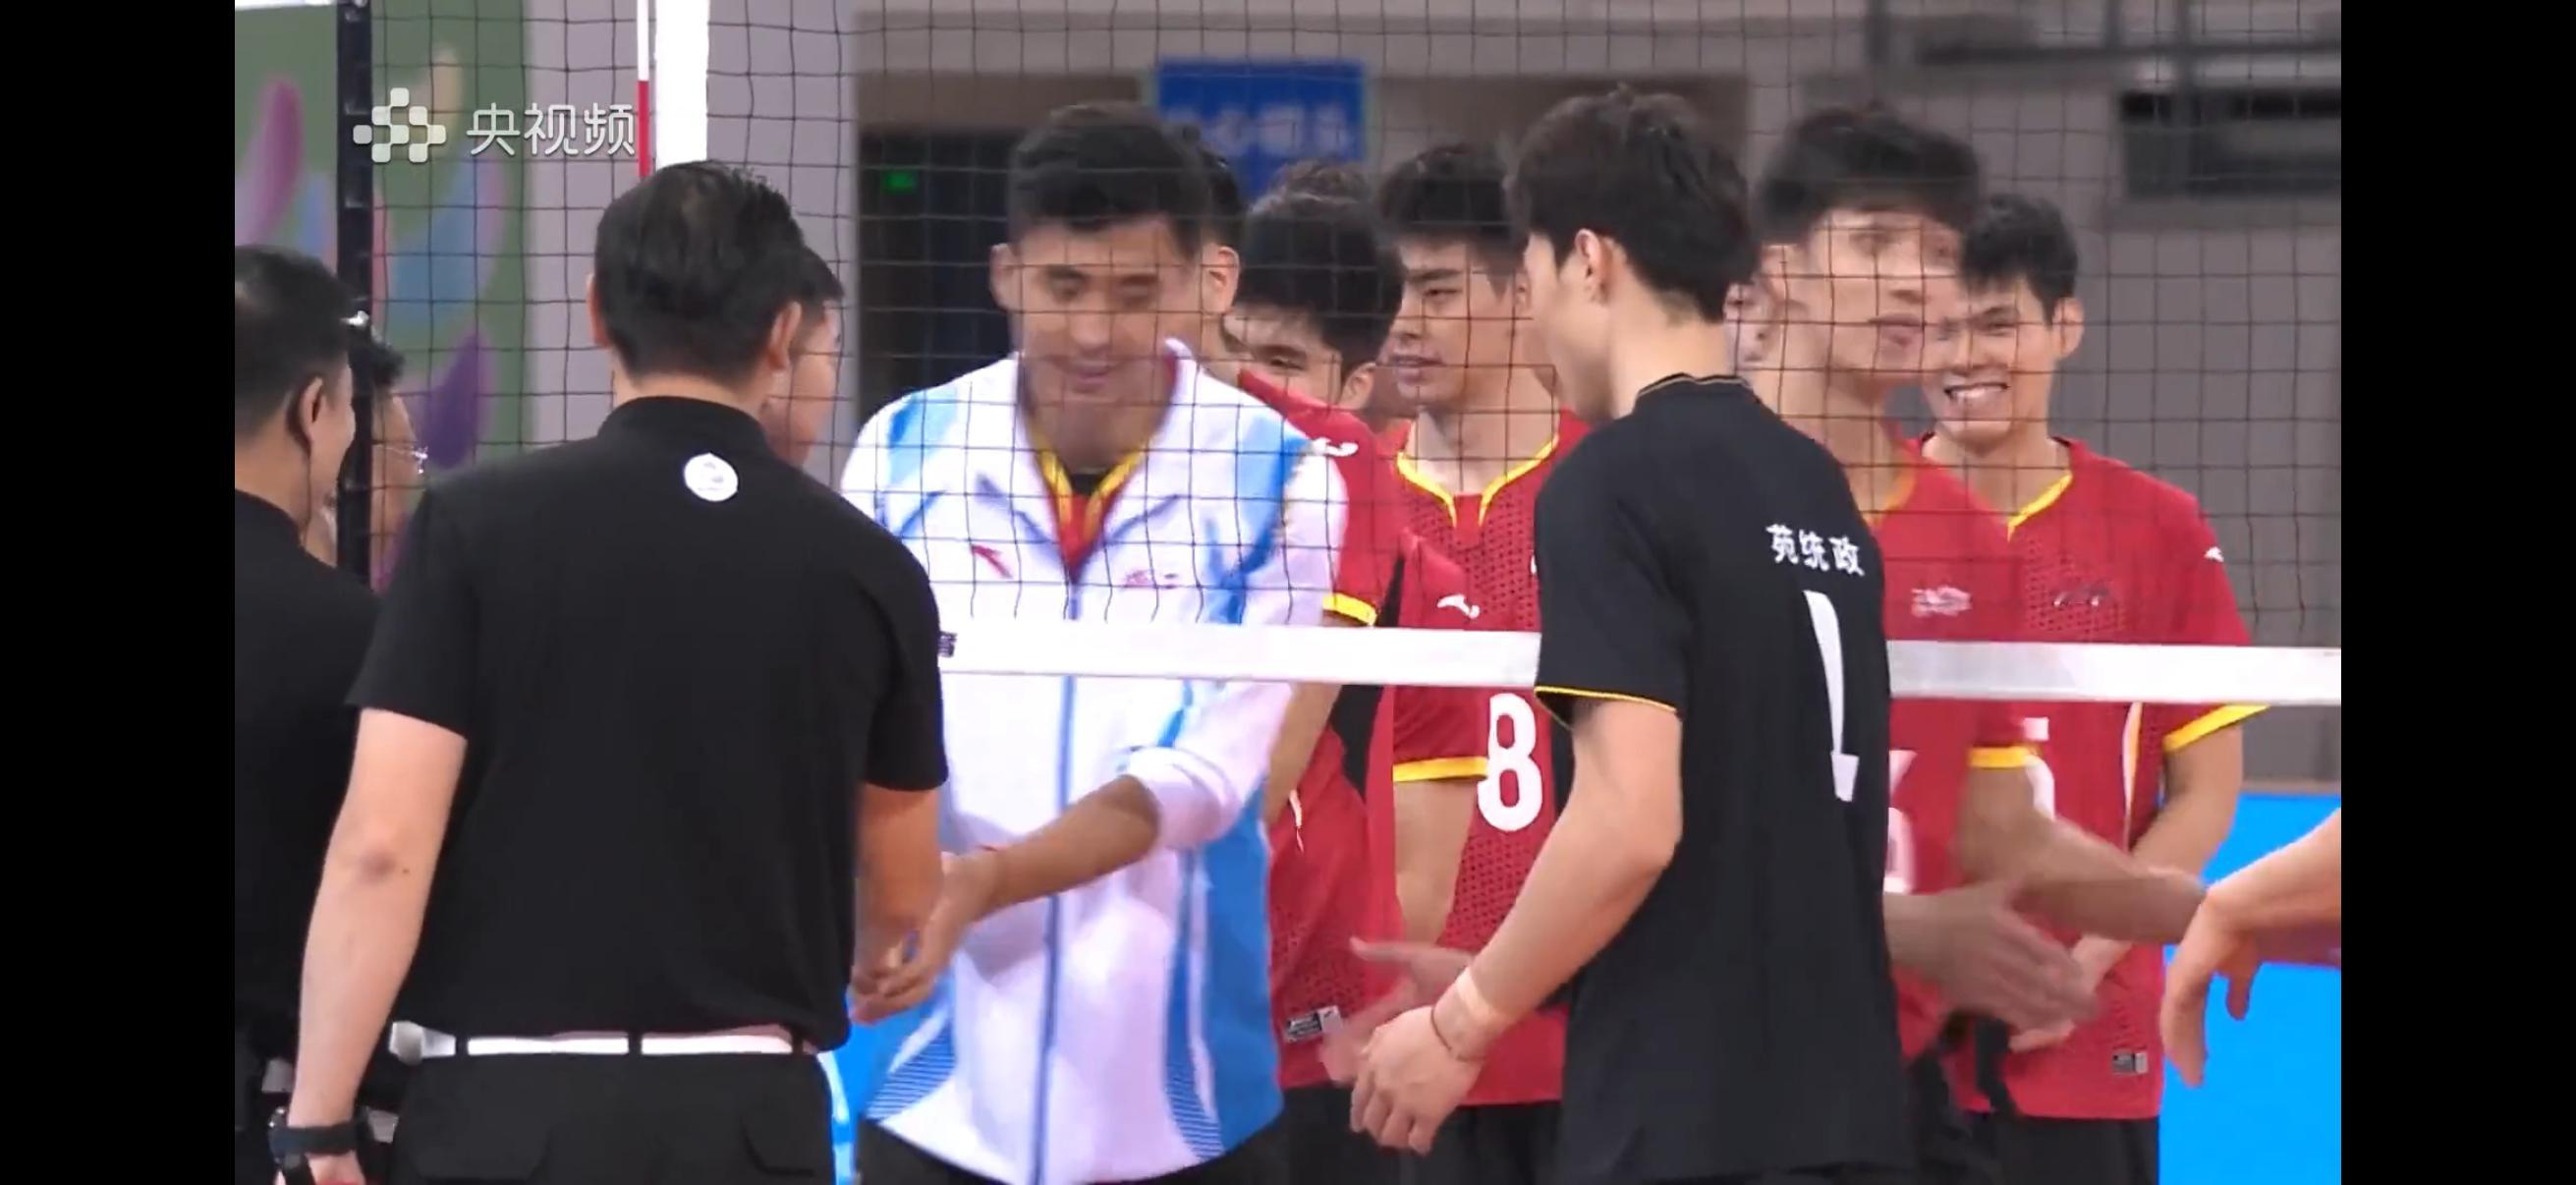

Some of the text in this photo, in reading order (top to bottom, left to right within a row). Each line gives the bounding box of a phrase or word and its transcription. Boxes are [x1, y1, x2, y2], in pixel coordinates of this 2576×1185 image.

[1765, 523, 1866, 577] 苑统政
[1477, 693, 1542, 832] 8
